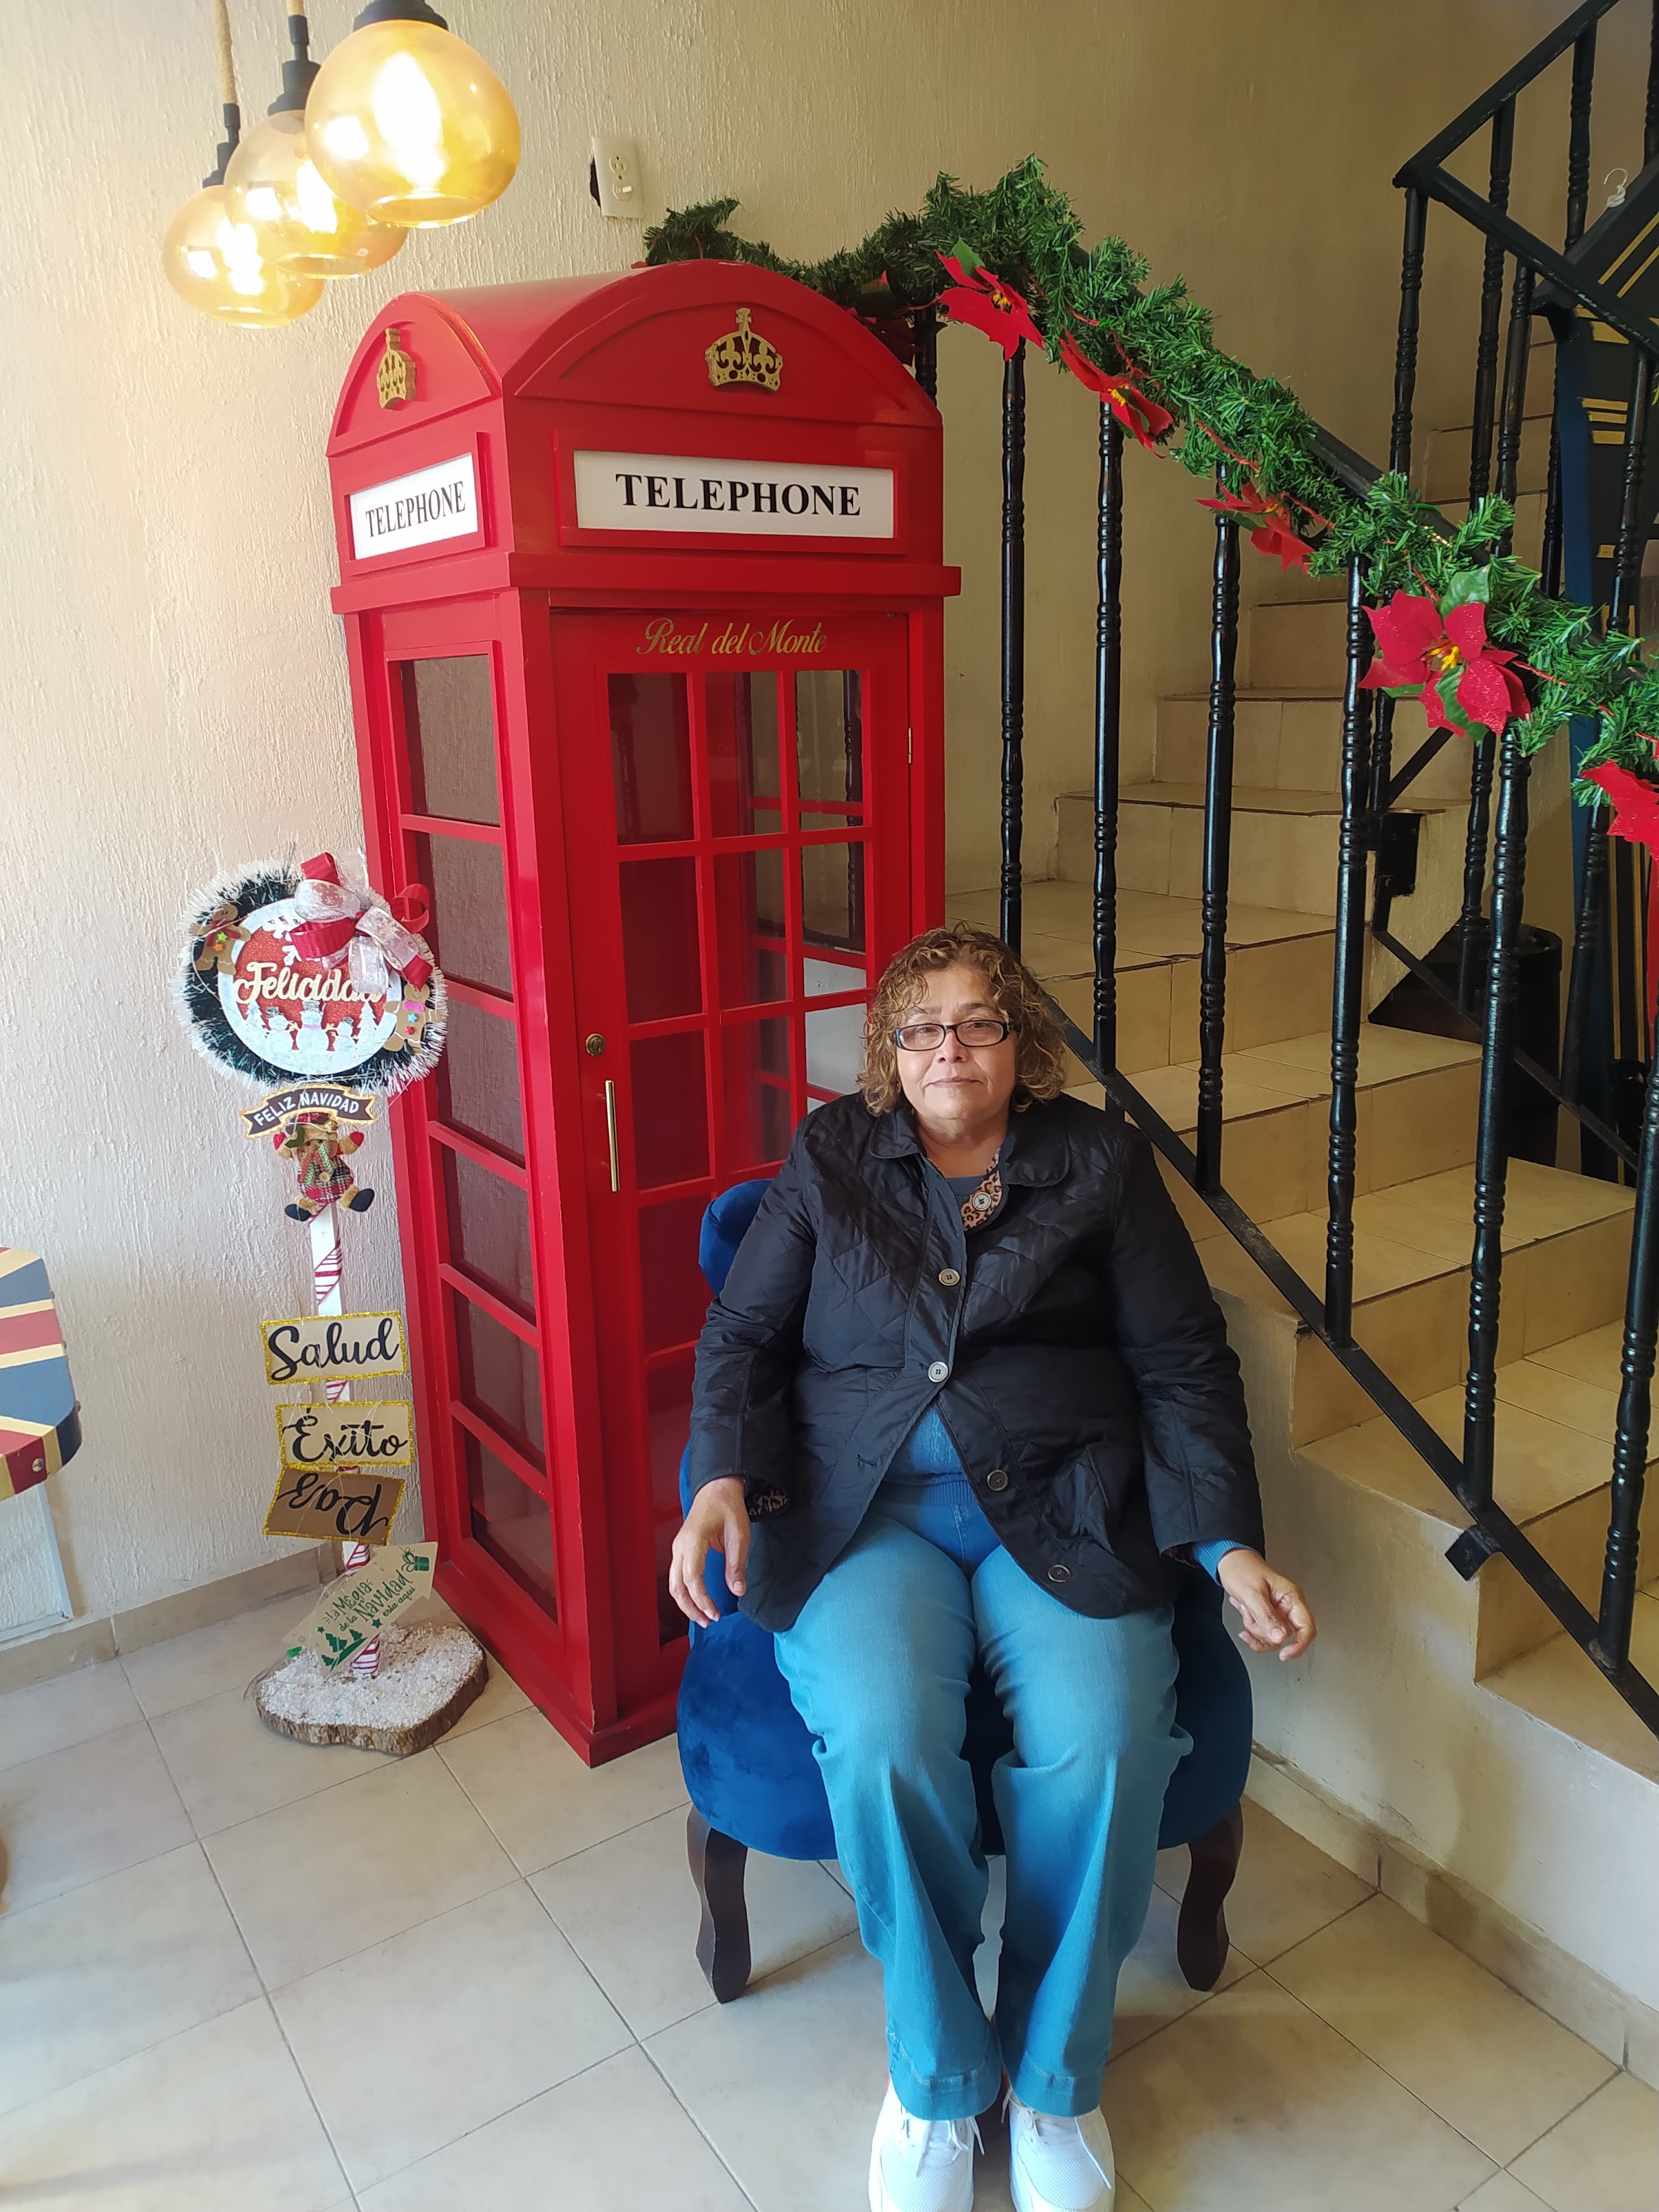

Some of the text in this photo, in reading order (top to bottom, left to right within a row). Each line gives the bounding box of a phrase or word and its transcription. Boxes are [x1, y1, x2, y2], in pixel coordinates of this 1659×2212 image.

[366, 481, 466, 538] TELEPHONE
[615, 473, 860, 515] TELEPHONE
[636, 618, 827, 655] Real del Monte
[234, 961, 383, 1004] Felicida
[253, 1092, 359, 1126] FELIZ NAVIDAD
[268, 1318, 399, 1381] Salud
[282, 1407, 408, 1463] Éxito
[276, 1473, 389, 1537] Paz
[325, 1611, 341, 1621] La
[339, 1569, 413, 1631] de la Navidad
